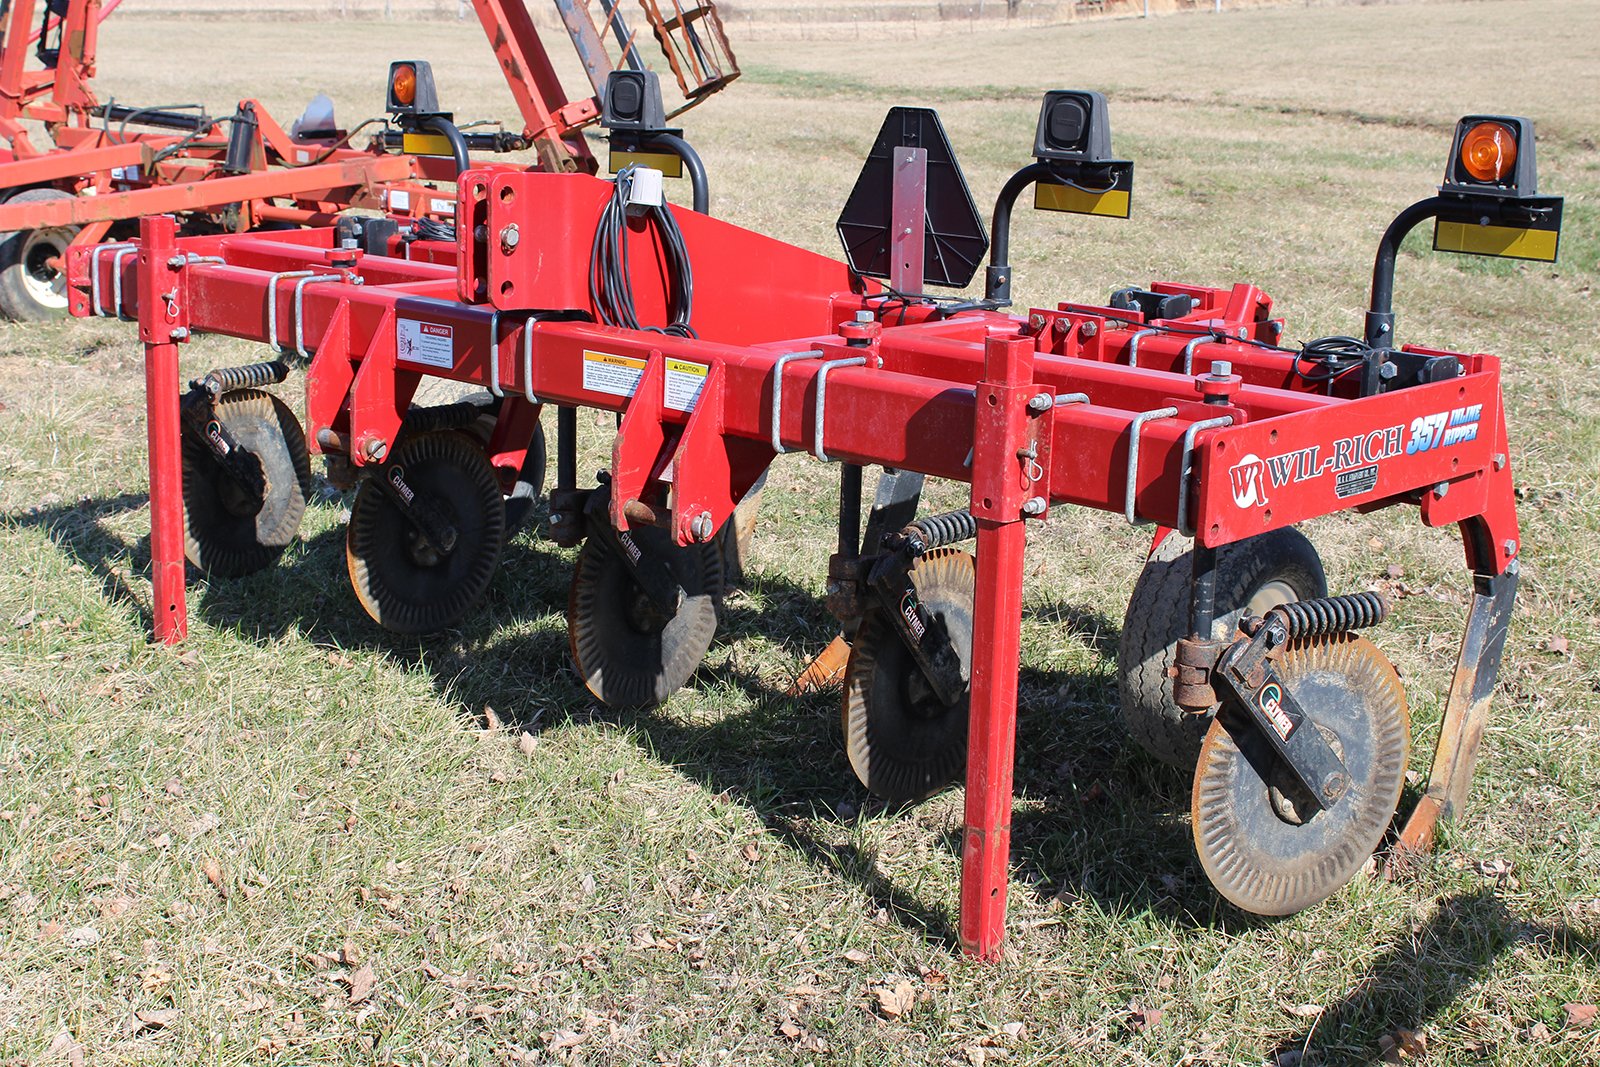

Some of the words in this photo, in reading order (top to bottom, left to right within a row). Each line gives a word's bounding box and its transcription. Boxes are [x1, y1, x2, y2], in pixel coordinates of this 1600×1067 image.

[430, 327, 449, 335] DANGER
[608, 358, 627, 366] WARNING
[679, 364, 700, 373] CAUTION
[1450, 404, 1482, 426] INLINE
[1406, 412, 1449, 455] 357
[1443, 423, 1478, 447] RIPPER
[1266, 424, 1405, 488] WIL-RICH
[393, 475, 414, 501] CLYMER
[621, 532, 641, 561] CLYMER
[904, 605, 926, 638] CLYMER
[1265, 698, 1294, 736] CLYMER
